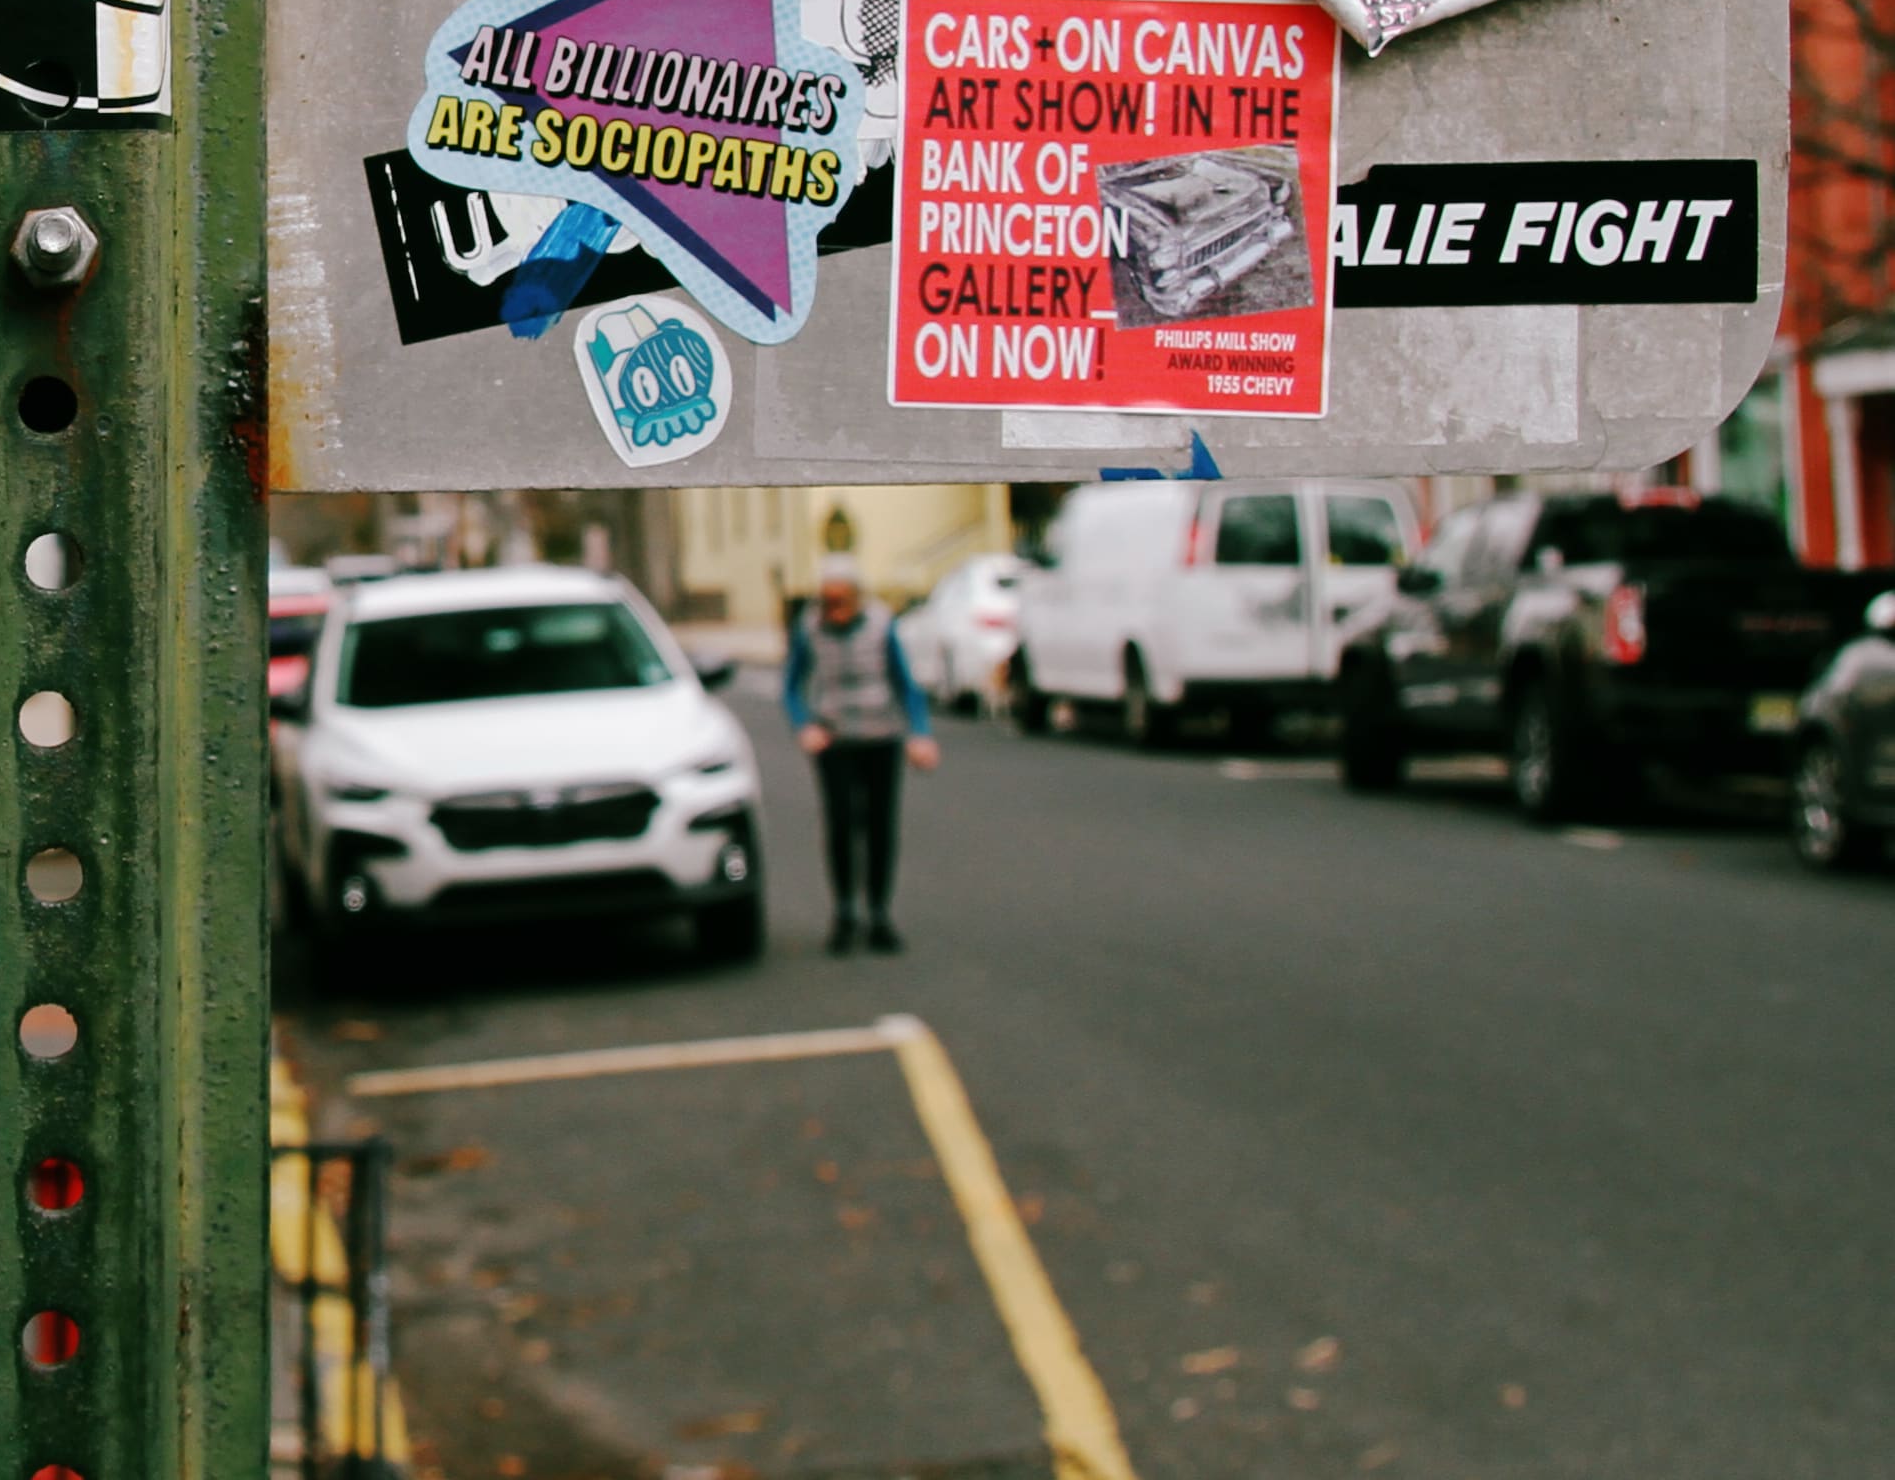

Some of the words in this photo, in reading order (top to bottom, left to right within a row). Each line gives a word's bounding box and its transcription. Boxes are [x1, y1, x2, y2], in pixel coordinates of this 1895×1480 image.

[1133, 20, 1304, 79] CANVAS
[460, 26, 540, 92] ALL
[544, 36, 844, 132] BILLIONAIRES
[923, 76, 1002, 130] ART
[1014, 80, 1157, 136] SHOW!
[1172, 84, 1213, 137] IN
[1230, 87, 1300, 139] THE
[425, 95, 525, 160] ARE
[531, 106, 840, 205] SOCIOPATHS
[921, 140, 1025, 194] BANK
[1036, 142, 1089, 195] OF
[920, 202, 1129, 259] PRINCETON
[1499, 199, 1733, 266] FIGHT
[914, 323, 979, 379] ON
[992, 326, 1105, 381] NOW!
[1155, 330, 1212, 349] PHILLIPS
[1215, 332, 1247, 351] MILL
[1250, 333, 1296, 352] SHOW
[1167, 352, 1223, 371] AWARD
[1227, 354, 1295, 374] WINNING
[1207, 375, 1240, 394] 1955
[1243, 376, 1295, 396] CHEVY
